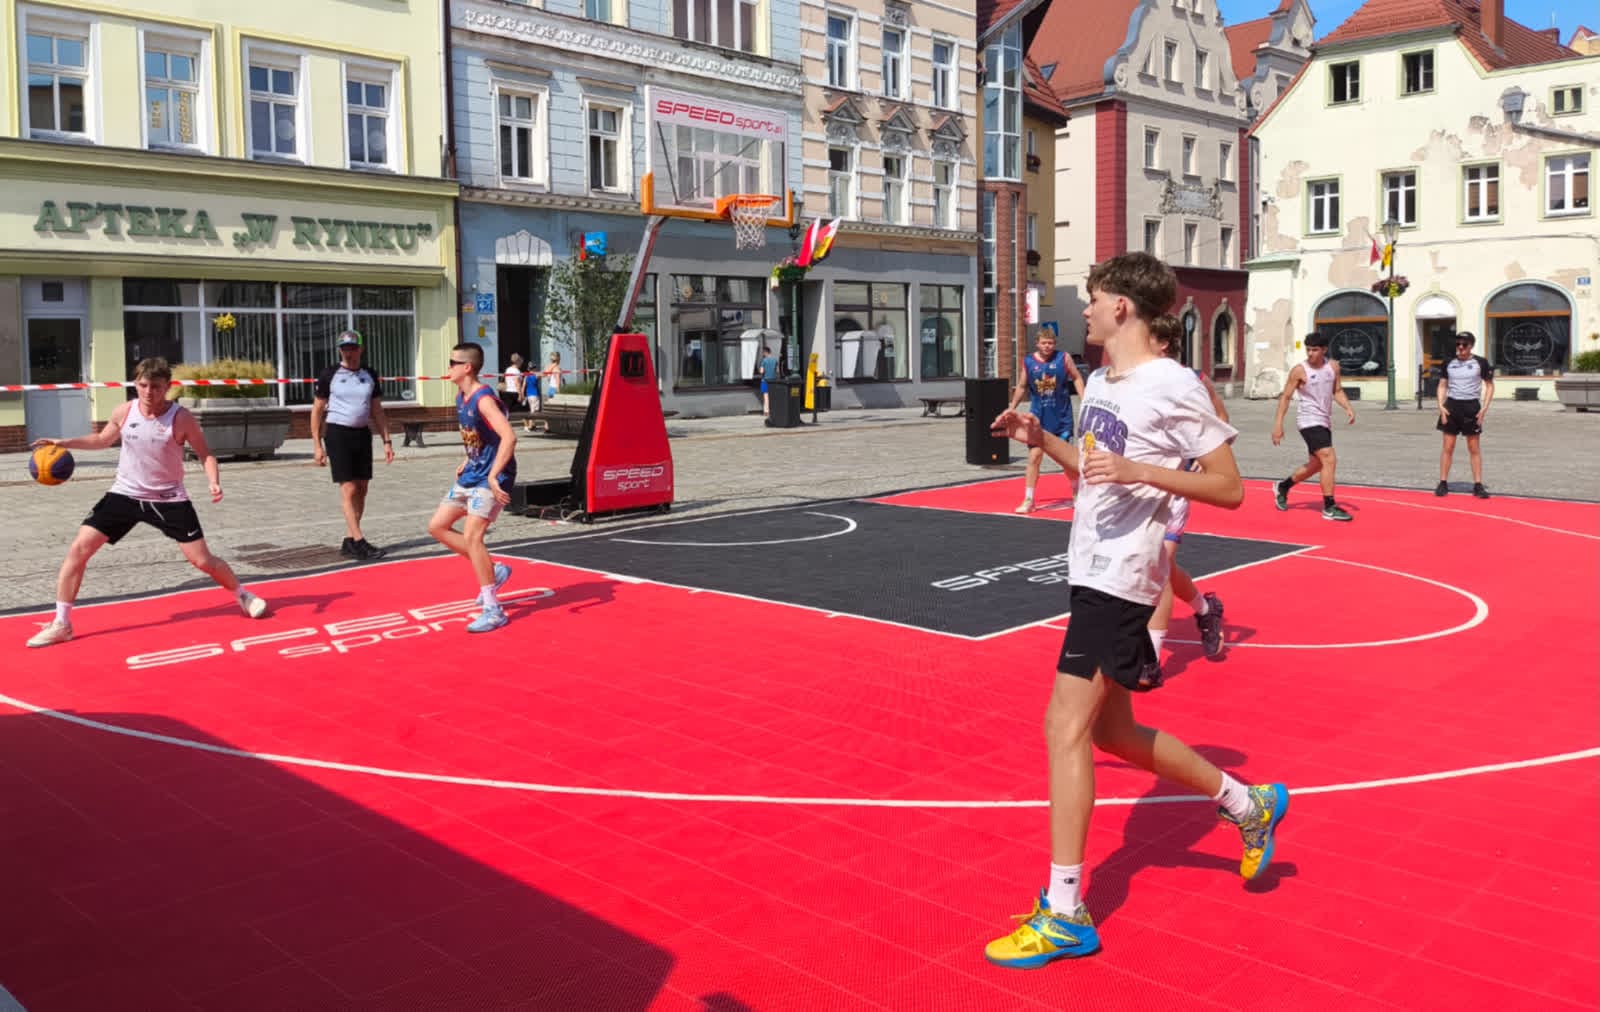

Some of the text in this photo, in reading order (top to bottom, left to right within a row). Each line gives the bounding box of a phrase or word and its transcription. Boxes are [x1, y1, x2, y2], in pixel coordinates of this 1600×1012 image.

[656, 99, 735, 125] SPEED
[34, 200, 218, 240] APTEKA
[603, 466, 664, 481] SPEED
[617, 479, 650, 492] sport
[930, 552, 1069, 592] SPE
[125, 587, 556, 670] SPEED
